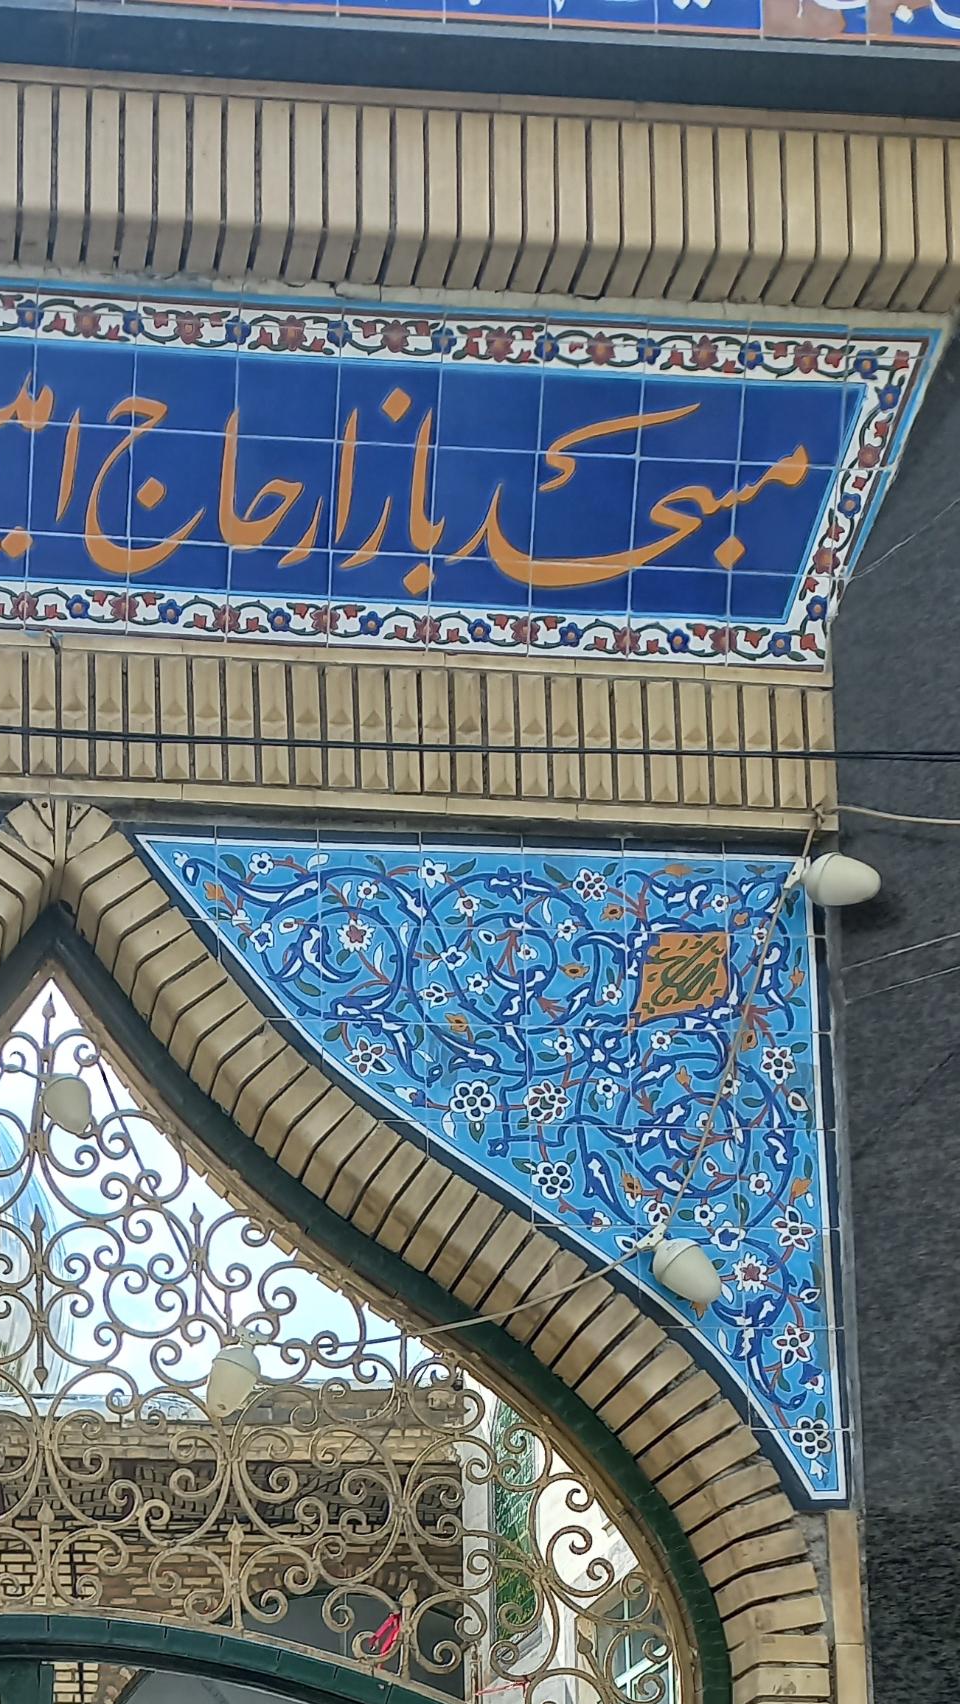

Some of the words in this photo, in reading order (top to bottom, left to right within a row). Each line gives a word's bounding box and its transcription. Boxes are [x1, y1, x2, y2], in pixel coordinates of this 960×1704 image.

[84, 395, 304, 574] حاج
[279, 386, 445, 596] بازار
[444, 402, 810, 588] مسجد
